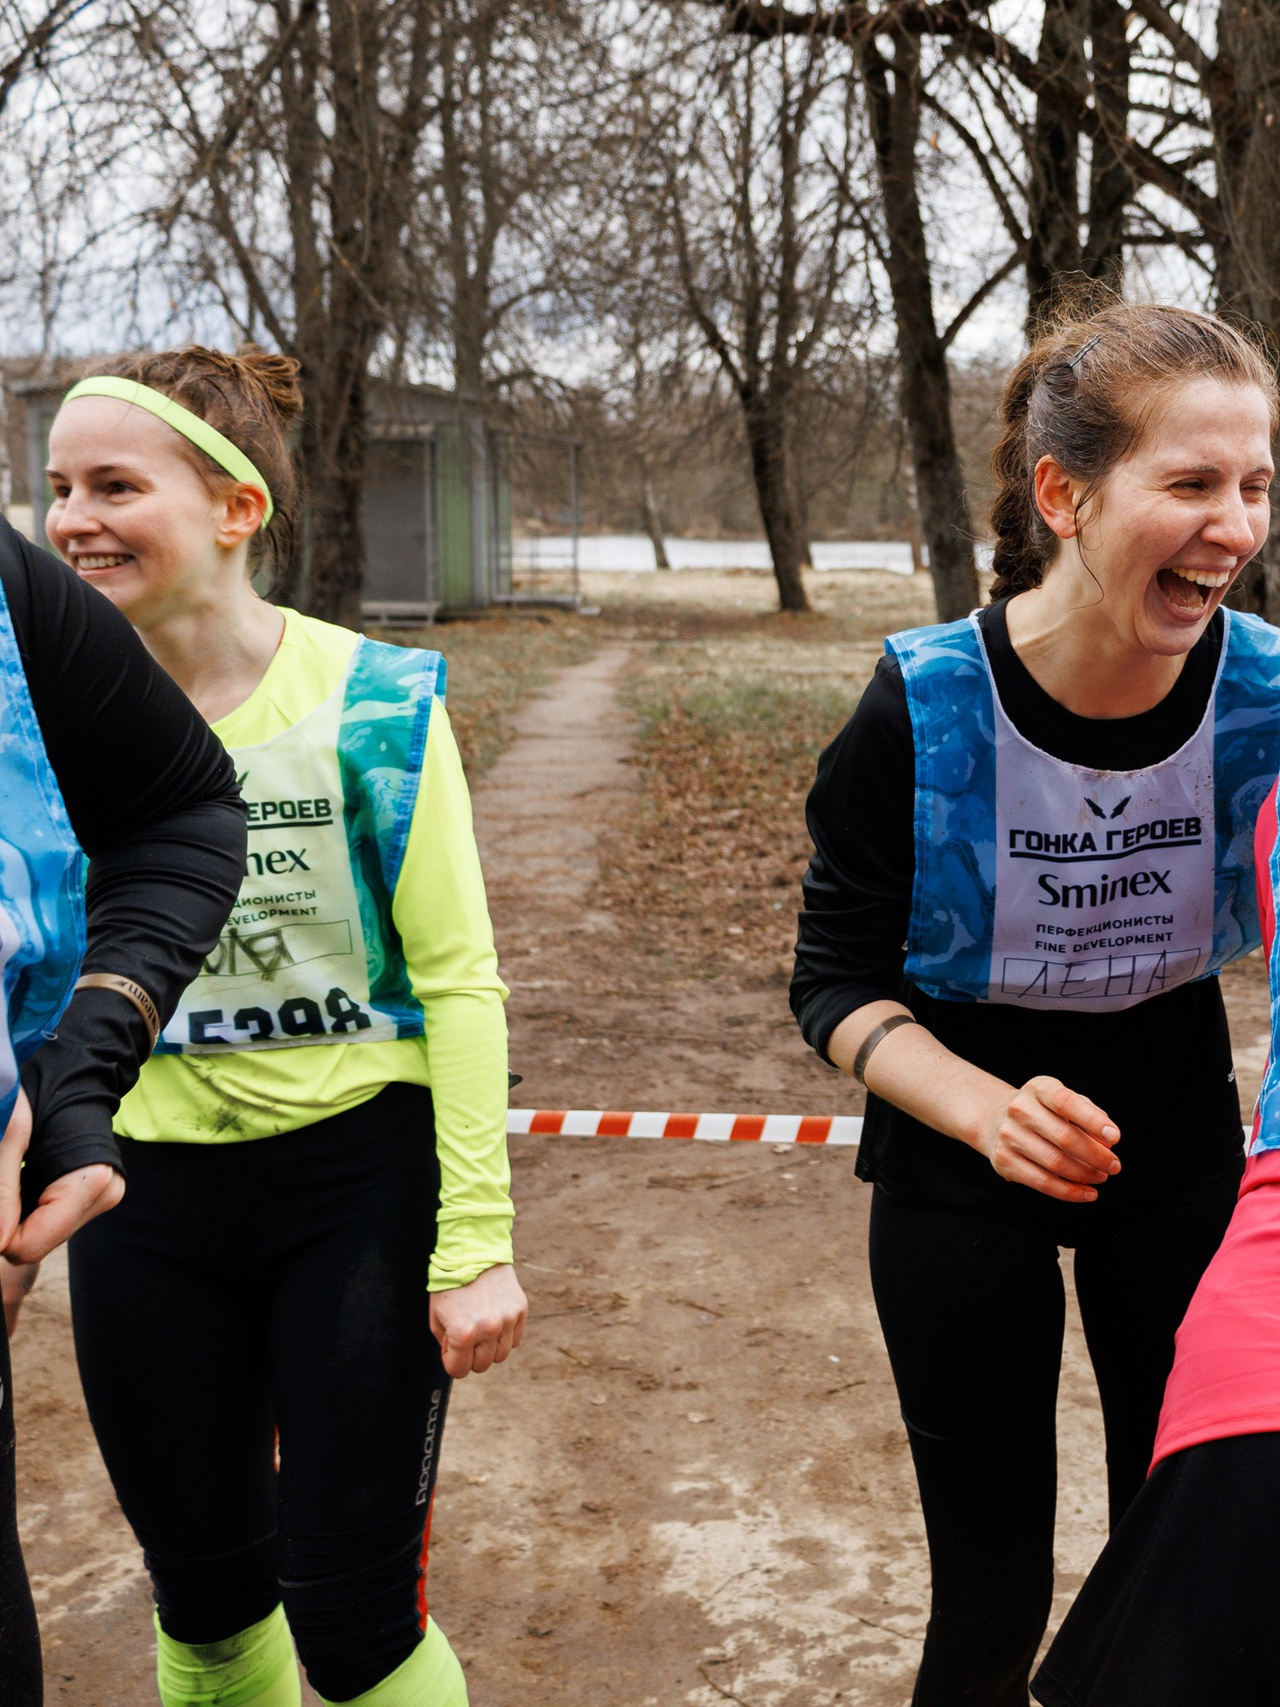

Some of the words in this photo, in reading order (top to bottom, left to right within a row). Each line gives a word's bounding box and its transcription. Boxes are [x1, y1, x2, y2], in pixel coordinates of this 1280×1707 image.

[247, 798, 332, 822] ЕРОЕВ
[1009, 829, 1097, 854] ГОНКА
[1106, 817, 1201, 850] ГЕРОЕВ
[244, 848, 311, 877] nex
[233, 890, 316, 909] ЦИОНИСТЫ
[1038, 870, 1172, 908] Sminex
[226, 907, 318, 926] EVELOPMENT
[1036, 914, 1174, 938] ПЕРФЕКЦИОНИСТЫ
[1035, 940, 1067, 954] FINE
[1073, 932, 1173, 953] DEVELOPMENT
[1017, 950, 1168, 998] ЛЕНА
[188, 987, 372, 1045] 5398
[415, 1388, 442, 1506] noname
